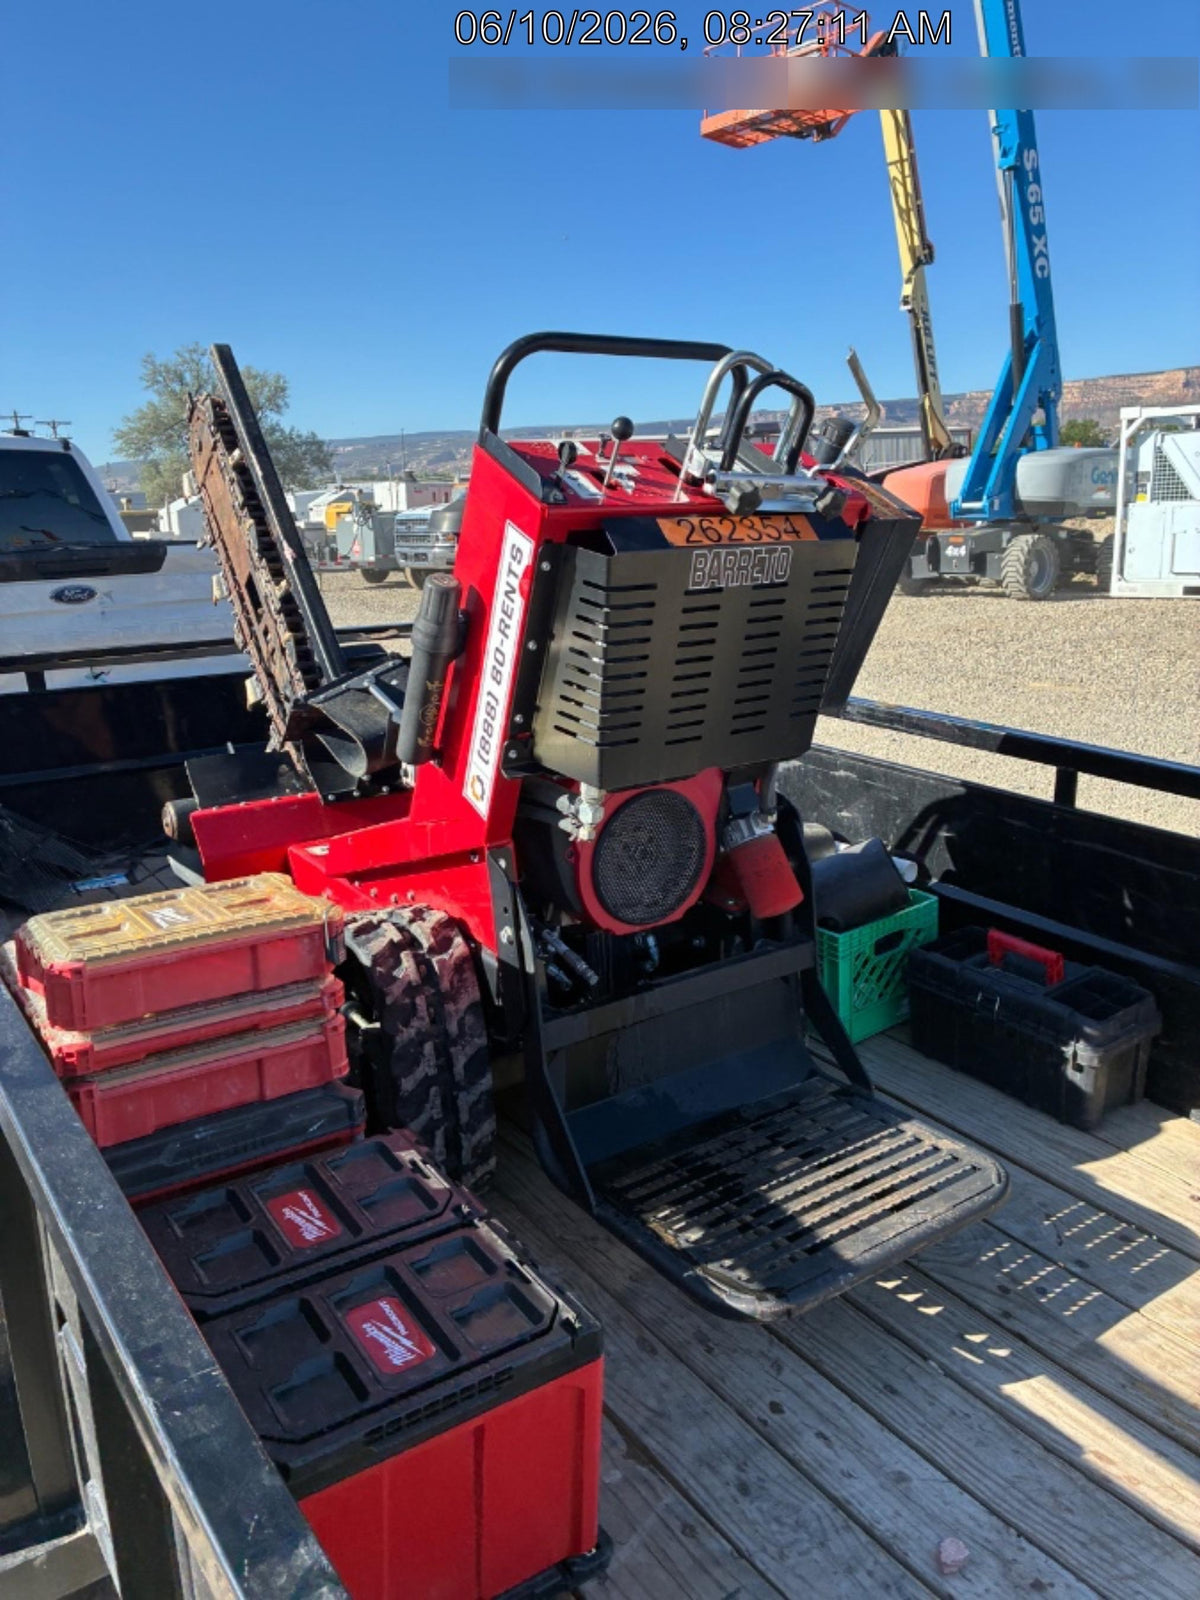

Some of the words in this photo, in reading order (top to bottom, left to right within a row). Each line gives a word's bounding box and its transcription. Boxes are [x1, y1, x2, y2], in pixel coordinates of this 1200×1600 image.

[1023, 148, 1044, 226] S-65
[1032, 234, 1049, 279] XC
[677, 517, 802, 545] 262354
[689, 546, 793, 589] BARRETO
[477, 692, 500, 766] (888)
